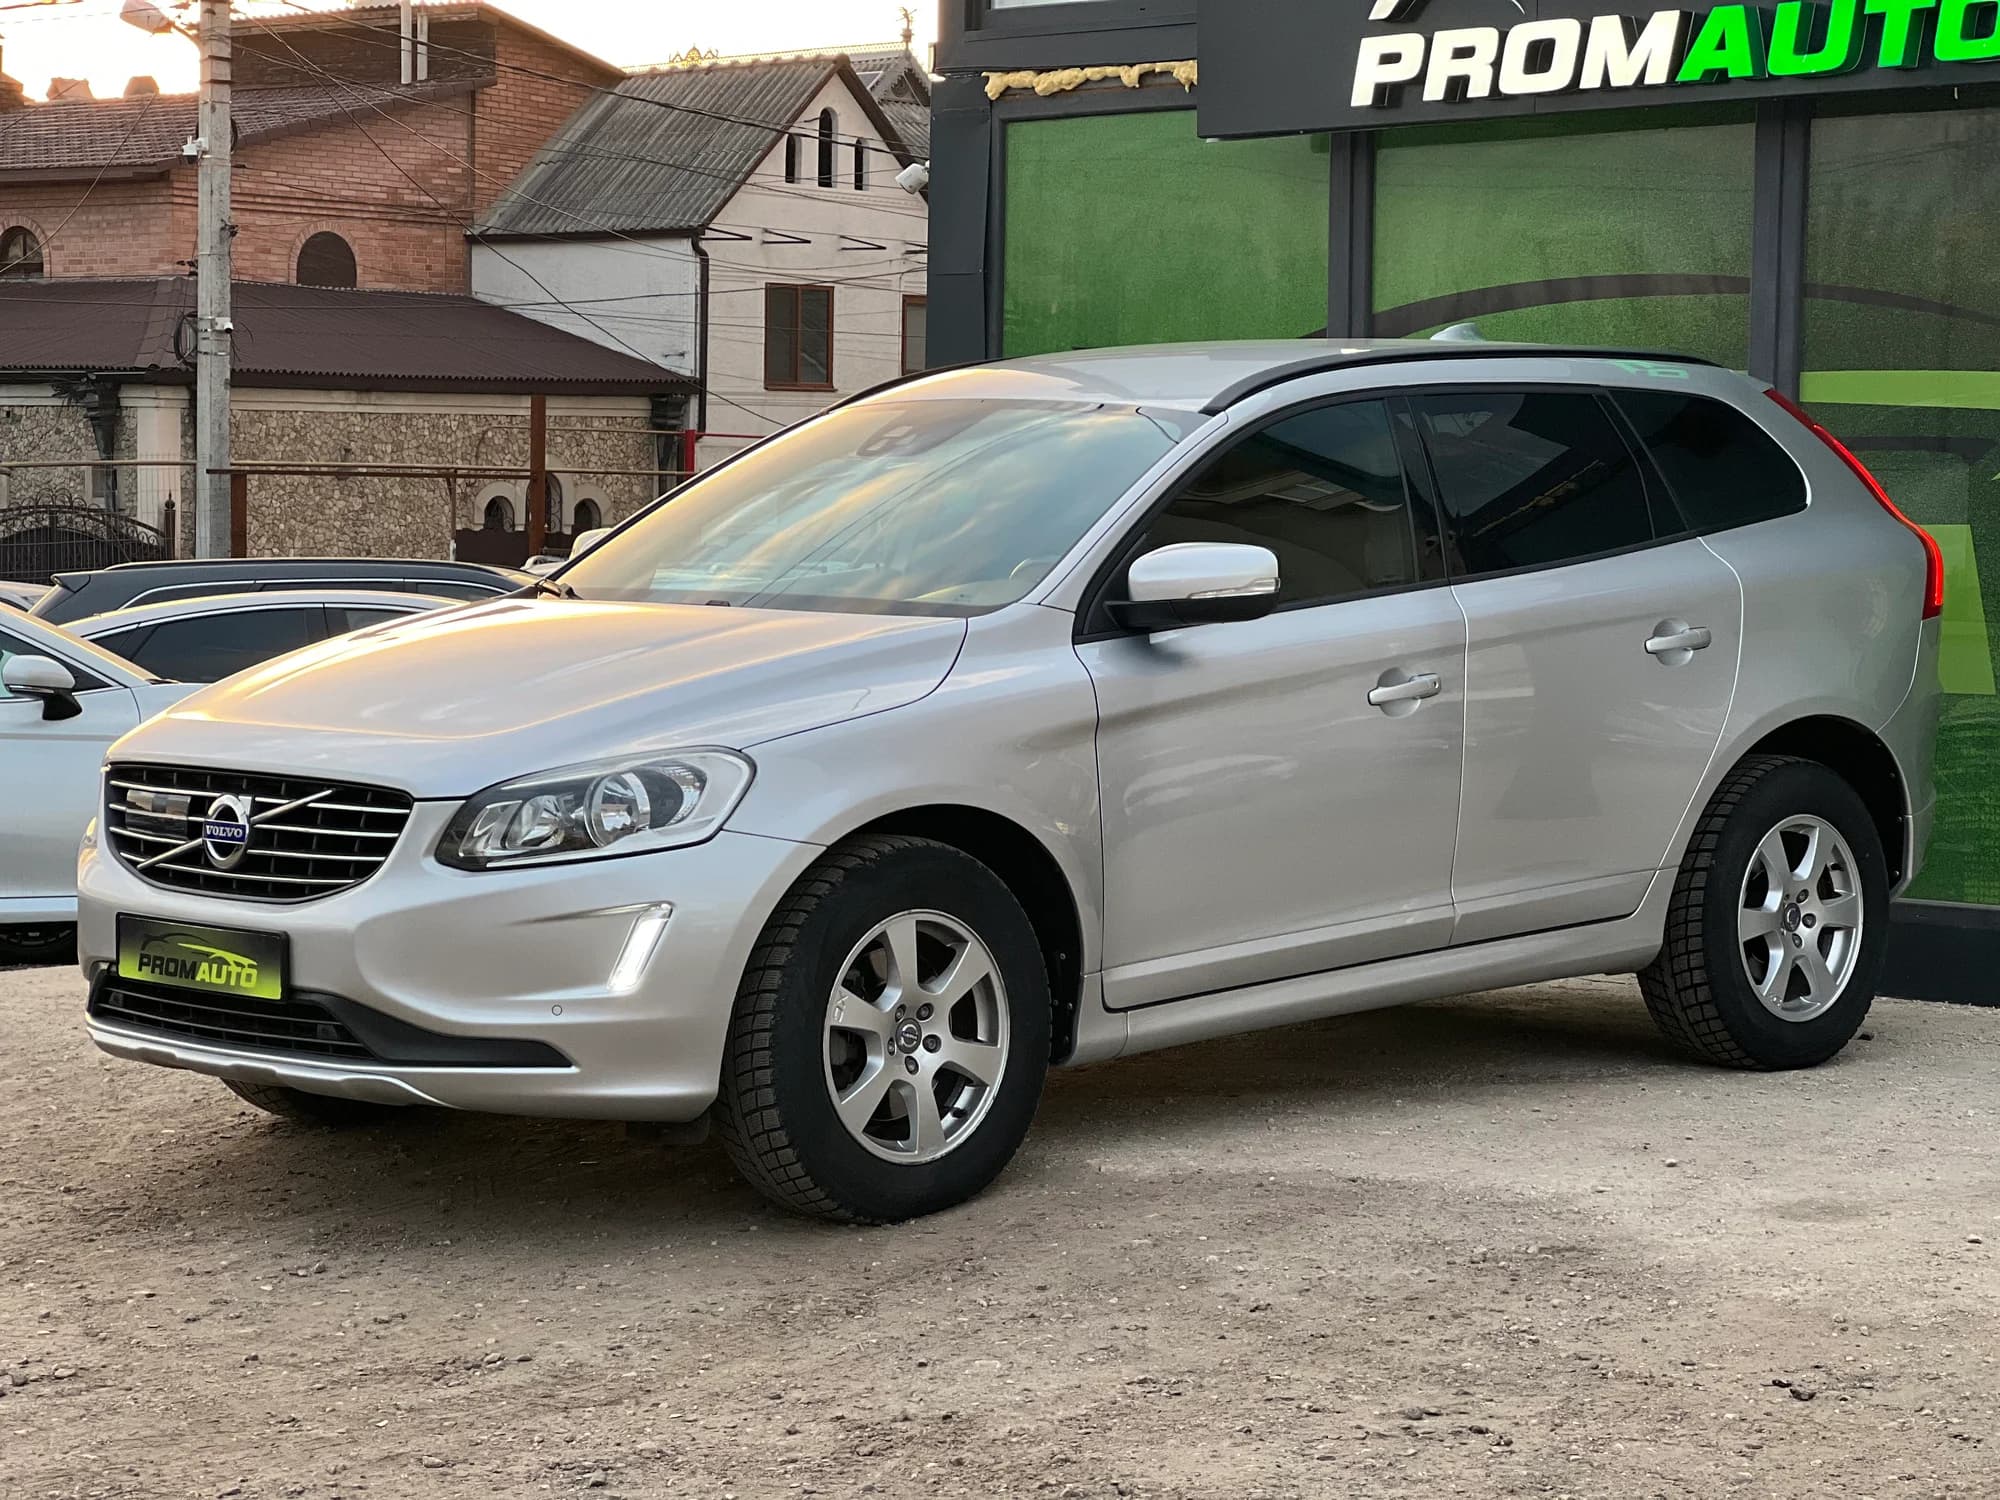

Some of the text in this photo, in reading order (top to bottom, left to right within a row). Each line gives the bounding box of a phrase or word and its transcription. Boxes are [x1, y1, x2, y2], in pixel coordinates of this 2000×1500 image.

[1350, 0, 2000, 107] PROMAUTO
[205, 824, 243, 838] VOLVO
[138, 953, 258, 988] PROMAUTO
